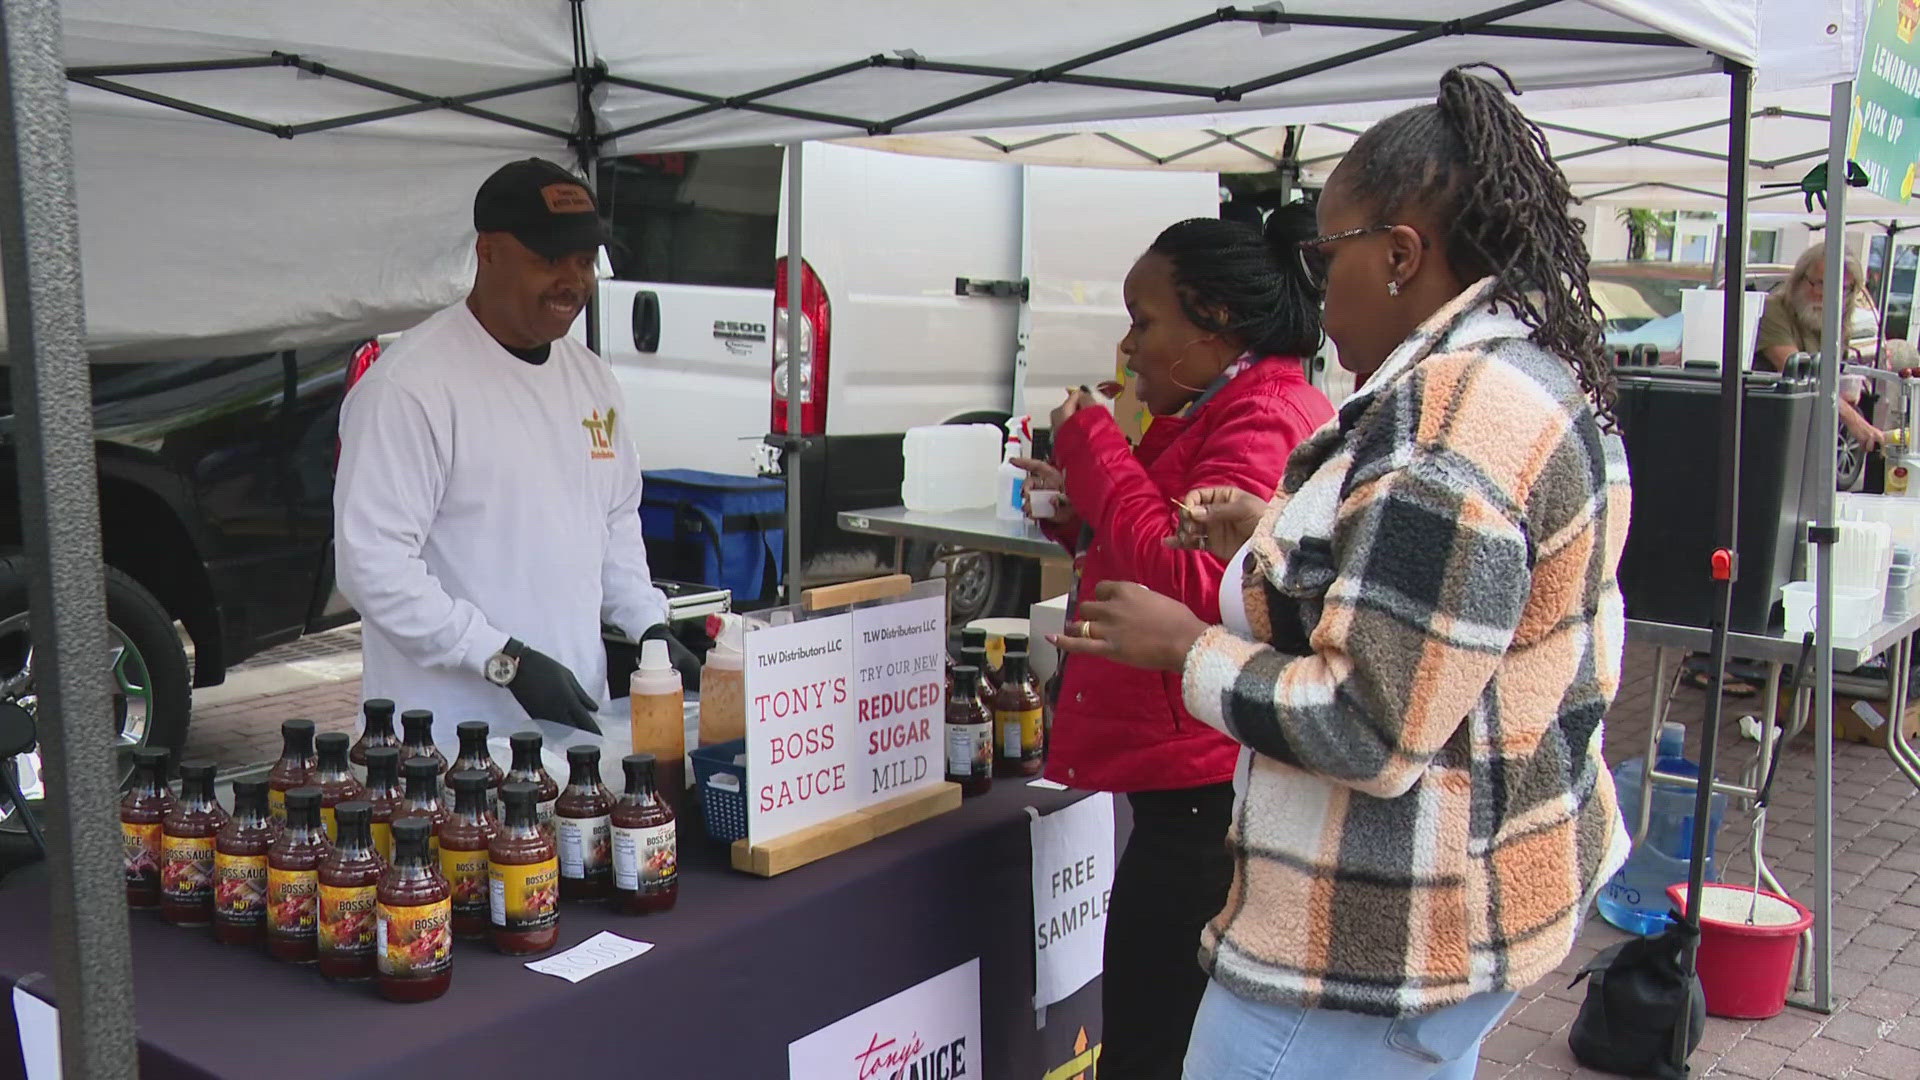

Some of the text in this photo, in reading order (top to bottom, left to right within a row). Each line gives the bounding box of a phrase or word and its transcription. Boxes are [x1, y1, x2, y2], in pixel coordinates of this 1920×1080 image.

[1863, 101, 1903, 145] PICK UP
[713, 320, 766, 333] 2500
[863, 619, 937, 643] TLW Distributors LLC
[758, 638, 842, 667] TLW Distributors LLC
[859, 653, 938, 682] TRY OUR NEW
[755, 677, 847, 722] TONY'S
[858, 682, 940, 723] REDUCED
[770, 724, 835, 765] BOSS
[868, 718, 931, 755] SUGAR
[872, 755, 928, 793] MILD
[760, 764, 846, 813] SAUCE
[646, 836, 664, 846] BOSS
[186, 849, 215, 861] SAUCE
[456, 863, 475, 872] BOSS
[1051, 855, 1095, 899] FREE
[179, 881, 195, 891] HOT
[281, 883, 304, 894] BOSS
[525, 874, 544, 886] BOSS
[233, 900, 249, 911] HOT
[339, 900, 363, 911] BOSS
[415, 917, 438, 930] BOSS
